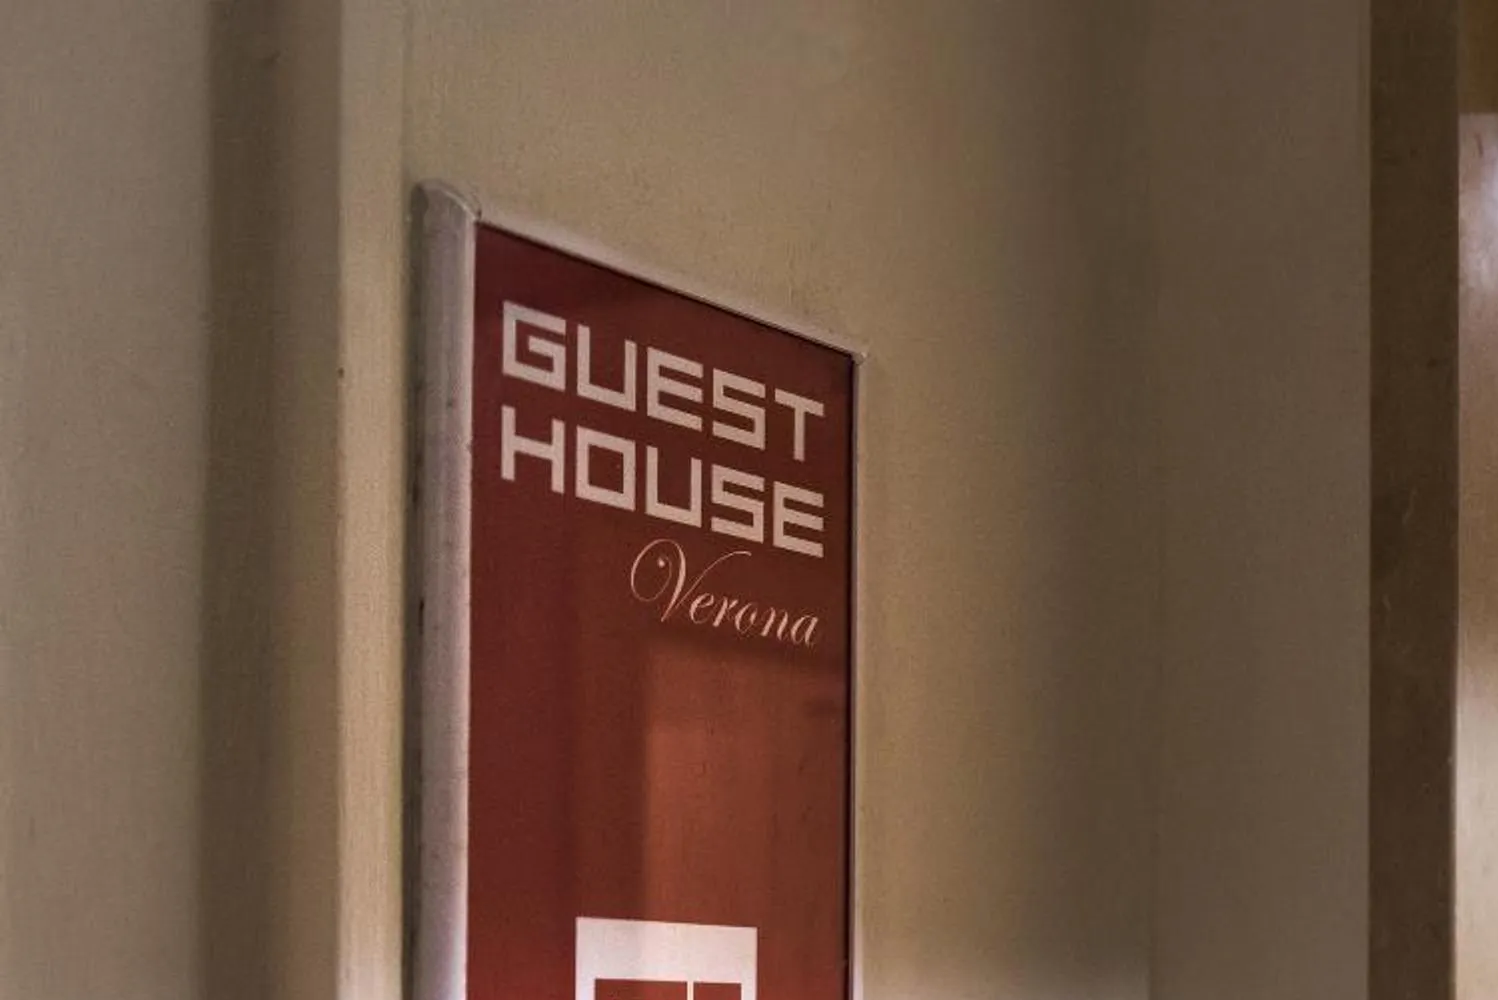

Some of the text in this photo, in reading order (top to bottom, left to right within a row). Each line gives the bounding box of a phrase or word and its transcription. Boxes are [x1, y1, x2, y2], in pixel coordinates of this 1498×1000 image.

[502, 300, 825, 462] GUEST
[501, 404, 824, 558] HOUSE
[630, 538, 819, 647] Verona
